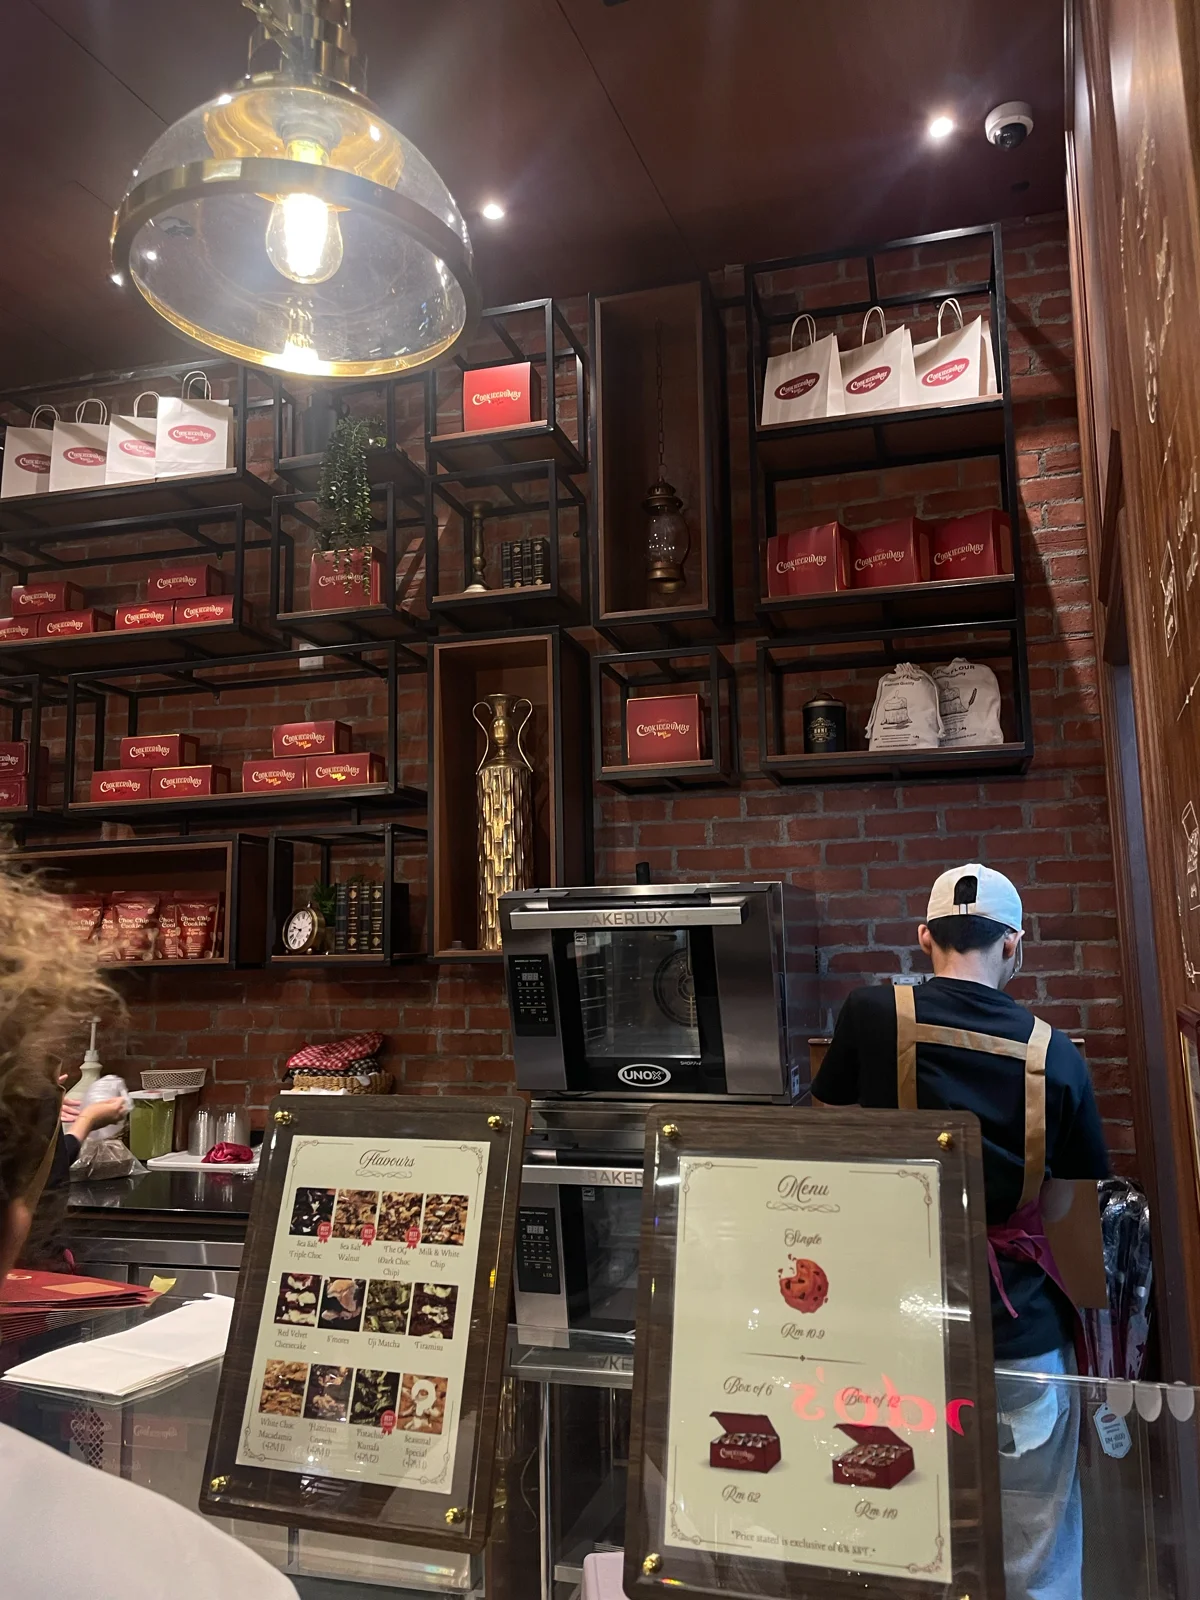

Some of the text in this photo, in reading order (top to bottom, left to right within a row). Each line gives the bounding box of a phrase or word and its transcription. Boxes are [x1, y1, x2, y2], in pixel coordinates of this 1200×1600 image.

[583, 910, 670, 926] AKERLUX
[623, 1070, 662, 1080] UNOX
[359, 1149, 416, 1169] Flavours
[777, 1174, 830, 1203] Menu
[784, 1228, 822, 1247] Single
[307, 1240, 318, 1248] Salt
[340, 1242, 361, 1251] Sea Salt
[383, 1245, 396, 1253] The
[288, 1250, 322, 1260] Triple Choc
[338, 1254, 360, 1262] Walnut
[418, 1248, 433, 1256] Milk
[440, 1249, 460, 1258] White
[394, 1257, 410, 1265] Choc
[430, 1260, 446, 1271] Chip
[277, 1328, 308, 1339] Red Velvet
[805, 1328, 825, 1340] 10.9
[377, 1338, 400, 1348] Matcha
[414, 1341, 444, 1352] Tiramisu
[723, 1375, 773, 1397] Box of 6
[841, 1386, 901, 1409] Box of 12
[260, 1417, 279, 1428] White
[721, 1484, 762, 1504] Rm 62
[854, 1500, 880, 1520] Rm
[756, 1534, 779, 1545] stated
[781, 1537, 789, 1546] is
[789, 1538, 826, 1551] exclusive
[827, 1542, 837, 1552] of
